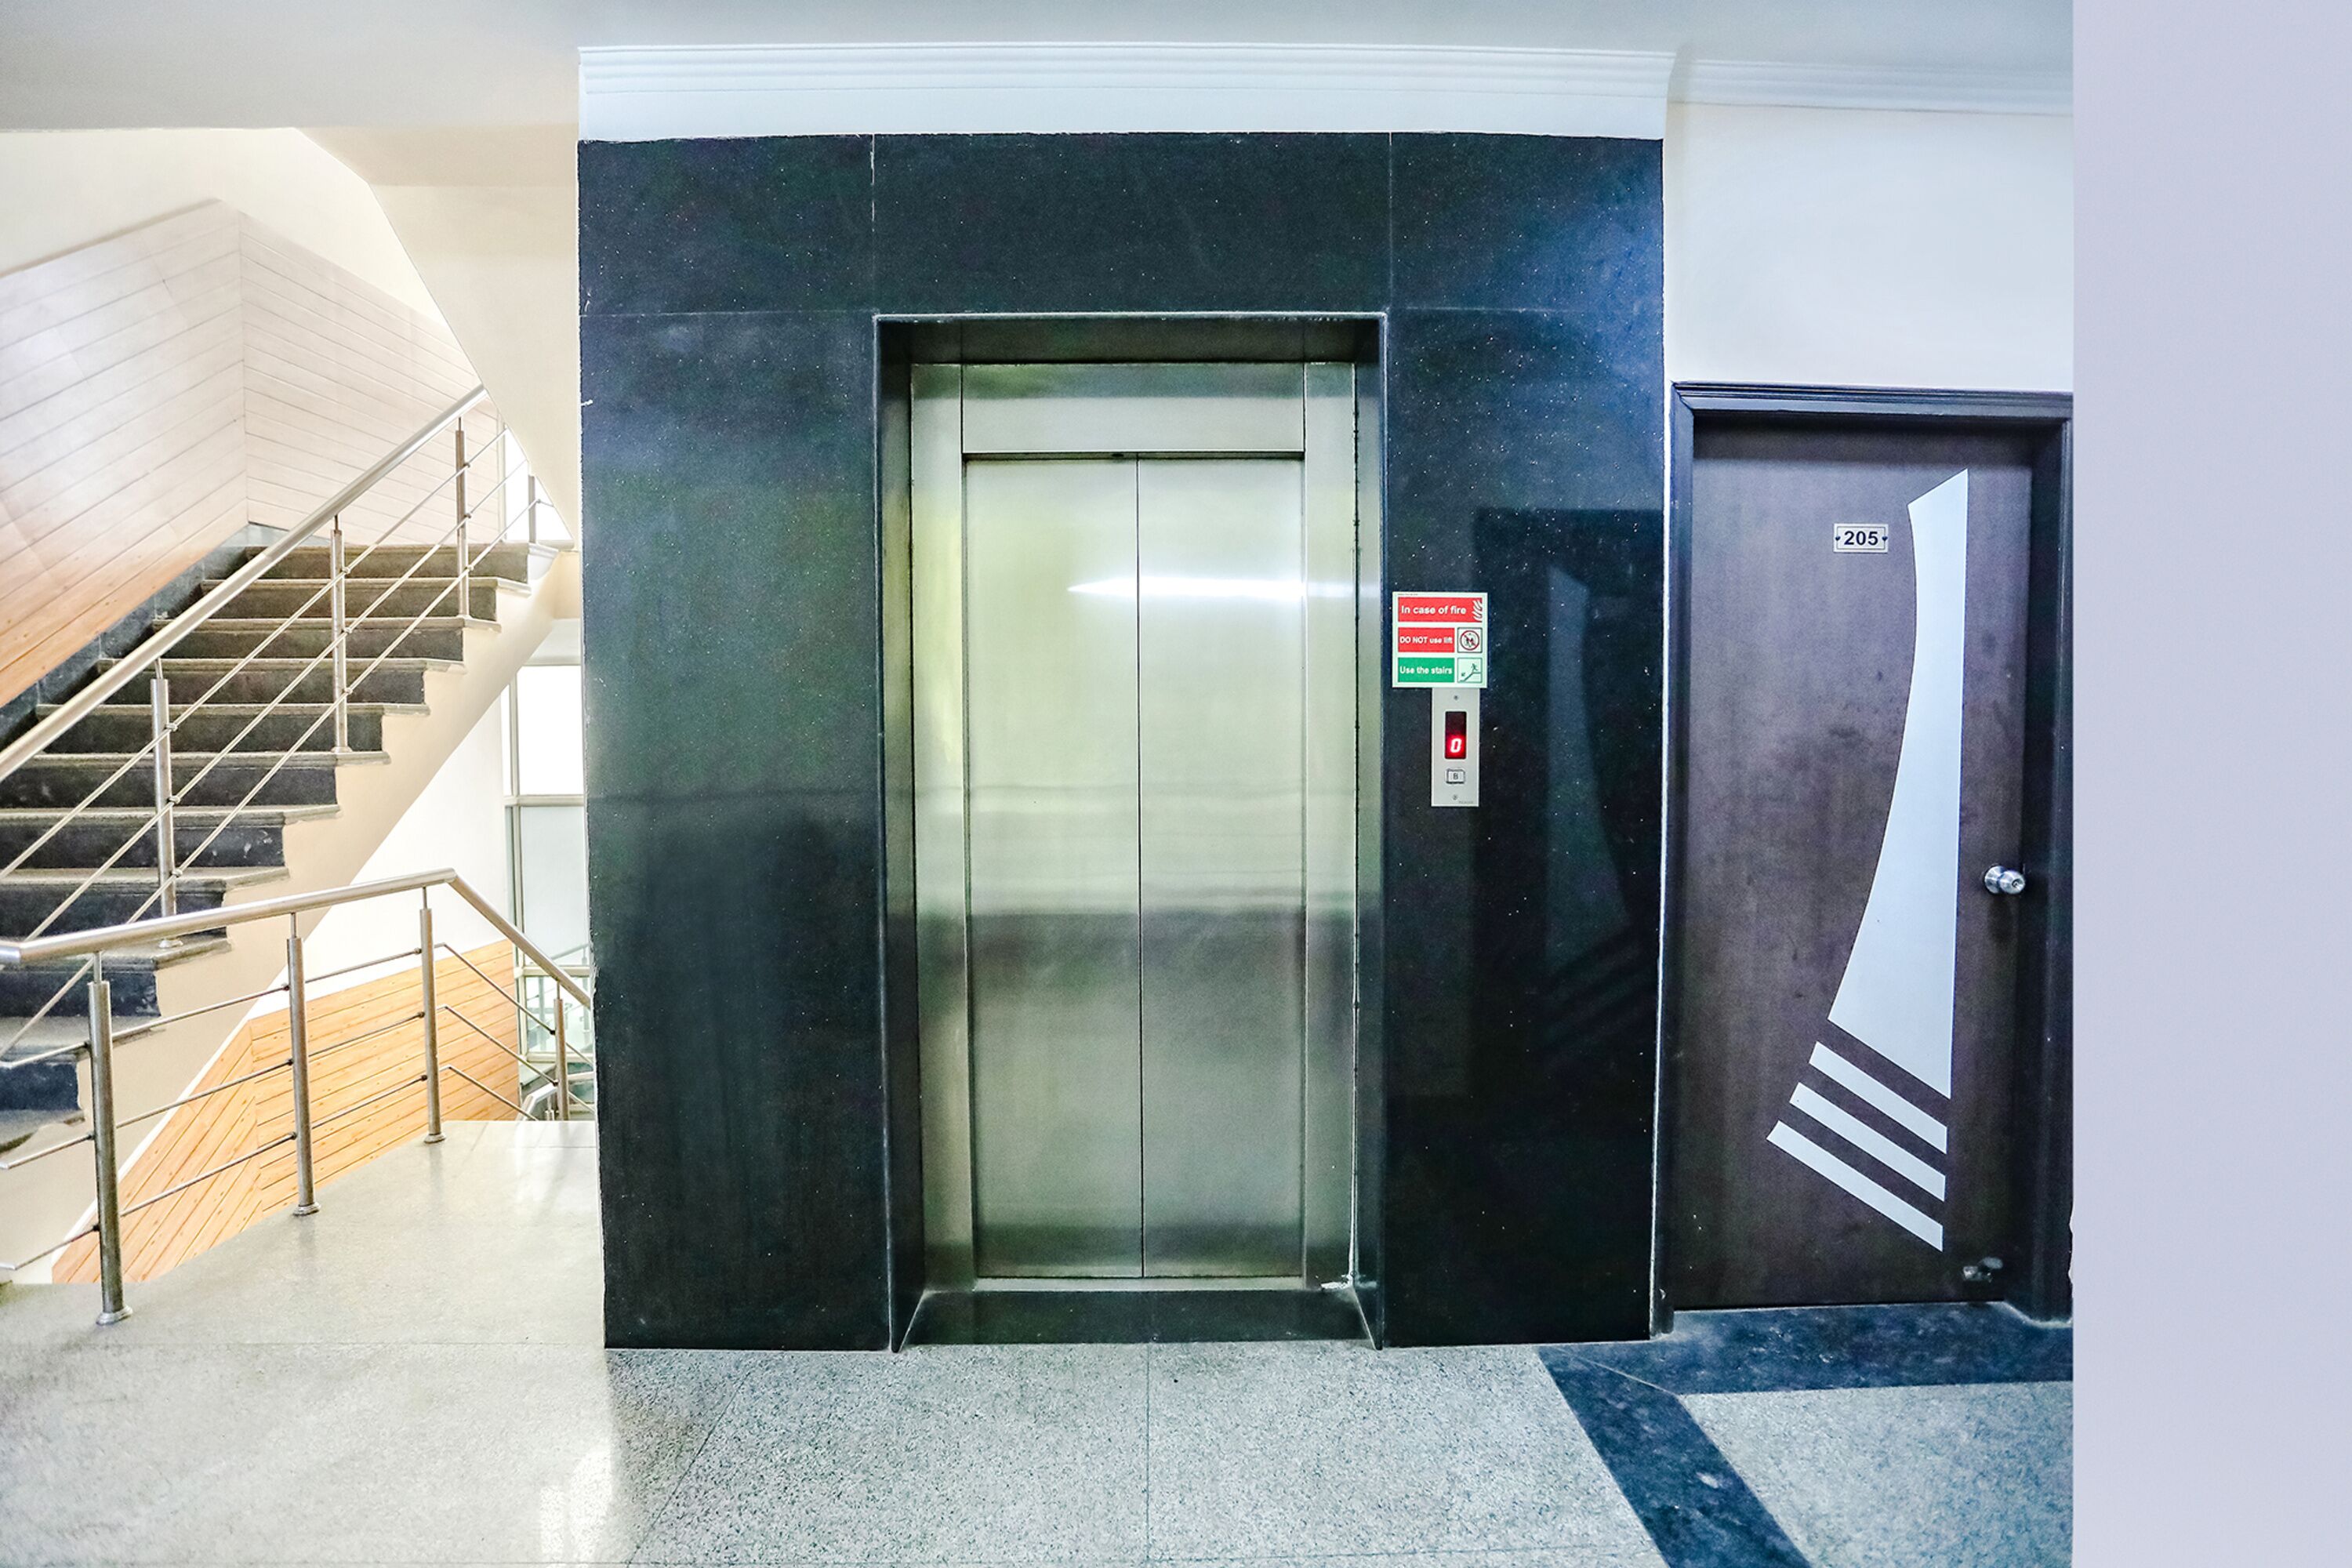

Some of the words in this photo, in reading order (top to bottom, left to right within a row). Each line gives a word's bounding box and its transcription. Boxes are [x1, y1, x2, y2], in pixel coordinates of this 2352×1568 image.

[1844, 531, 1878, 546] 205
[1401, 605, 1410, 614] In
[1438, 605, 1448, 615] of
[1450, 605, 1467, 615] fire
[1399, 666, 1414, 674] Use
[1417, 666, 1429, 674] the
[1431, 666, 1453, 674] stairs
[1450, 738, 1462, 753] 0
